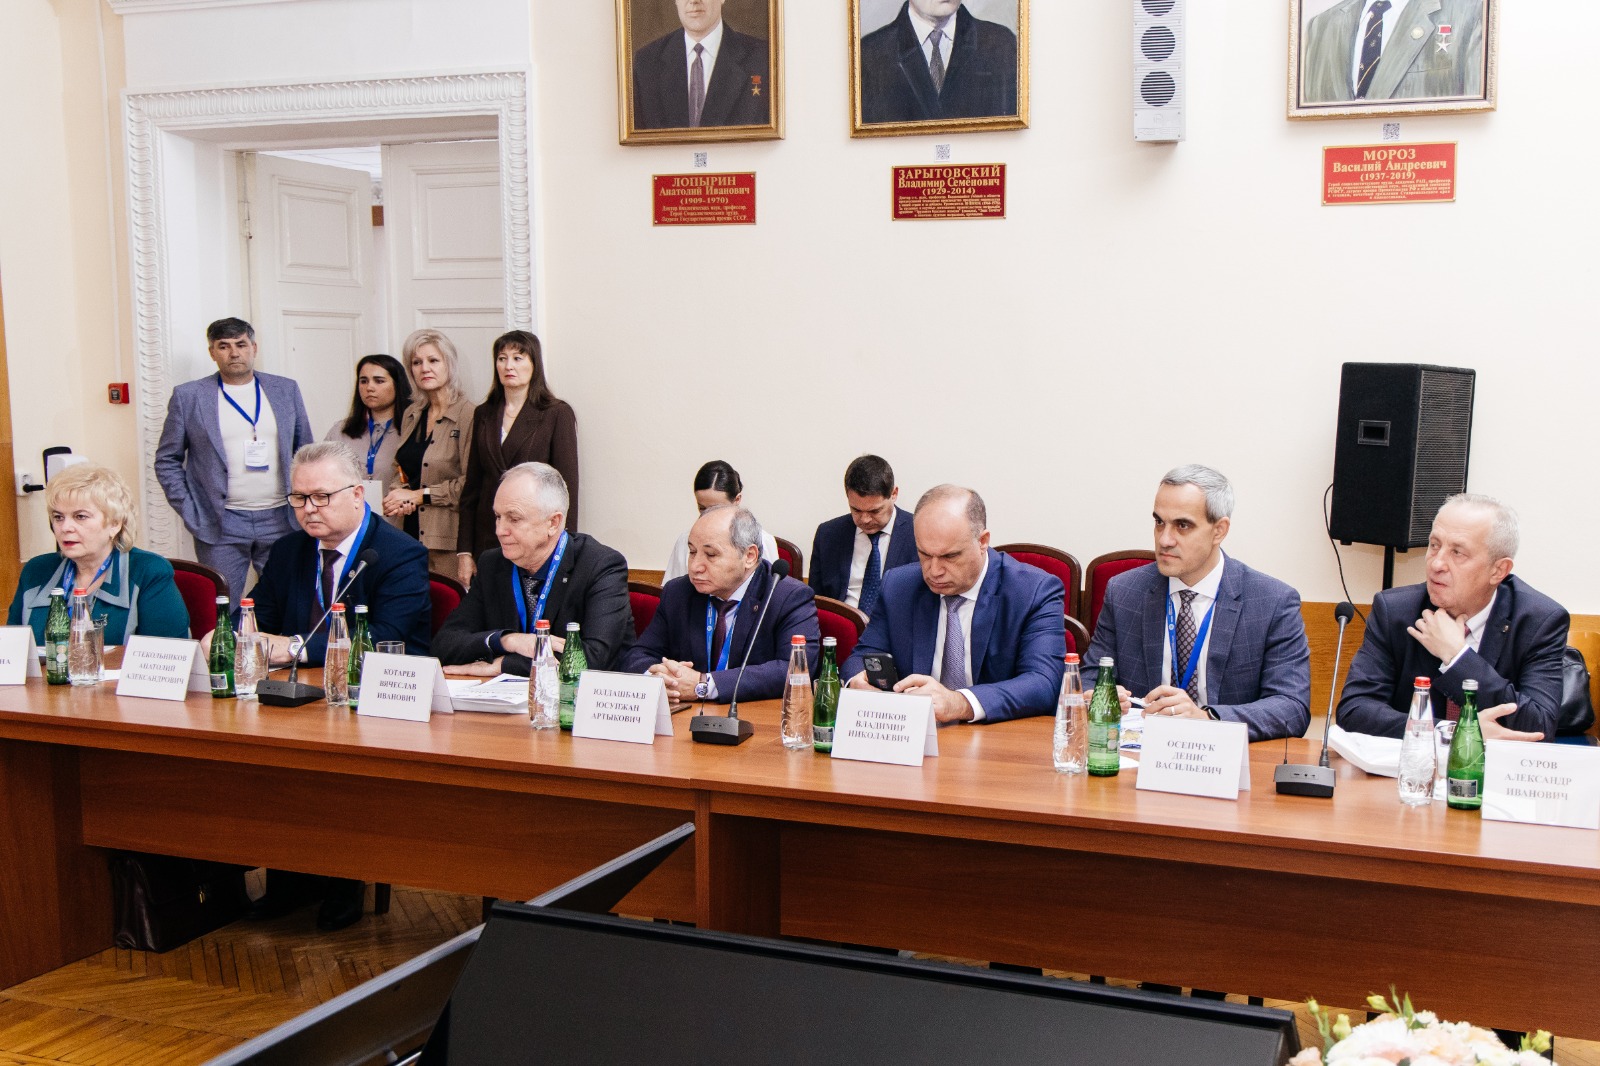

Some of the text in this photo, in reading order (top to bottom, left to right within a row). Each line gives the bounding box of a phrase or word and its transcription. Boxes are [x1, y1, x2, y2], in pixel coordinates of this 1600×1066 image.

[1363, 149, 1416, 161] МОРОЗ
[898, 165, 1000, 179] ЗАРЫТОВСКИЙ
[1333, 160, 1447, 172] Василий Андреевич
[672, 176, 736, 187] ЛОПЫРИН
[1360, 172, 1416, 181] (1937-2019)
[898, 177, 1000, 189] Владимир Семёнович
[660, 186, 750, 196] Анатолий Иванович
[922, 188, 976, 196] (1929-2014)
[132, 650, 188, 662] СТЕКОЛЬНИКОВ
[138, 662, 176, 672] АНАТОЛИЙ
[383, 668, 416, 678] КОТАРЕВ
[126, 673, 184, 685] АЛЕКСАНДРОВИЧ
[379, 680, 417, 690] ВЯЧЕСЛАВ
[377, 692, 416, 702] ИВАНОВИЧ
[594, 688, 646, 700] ЮЛДАШБАЕВ
[596, 701, 640, 712] ЮСУПЖАН
[592, 712, 640, 724] АРТЫКОВИЧ
[858, 710, 906, 721] СИТНИКОВ
[856, 720, 906, 732] ВЛАДИМИР
[848, 730, 910, 742] НИКОЛАЕВИЧ
[1167, 740, 1216, 752] ОСЕПЧУК
[1172, 752, 1208, 762] ДЕНИС
[1156, 761, 1222, 774] ВАСИЛЬЕВИЧ
[1520, 758, 1558, 769] СУРОВ
[1504, 774, 1572, 786] АЛЕКСАНДР
[1506, 788, 1568, 800] ИВАНОВИЧ
